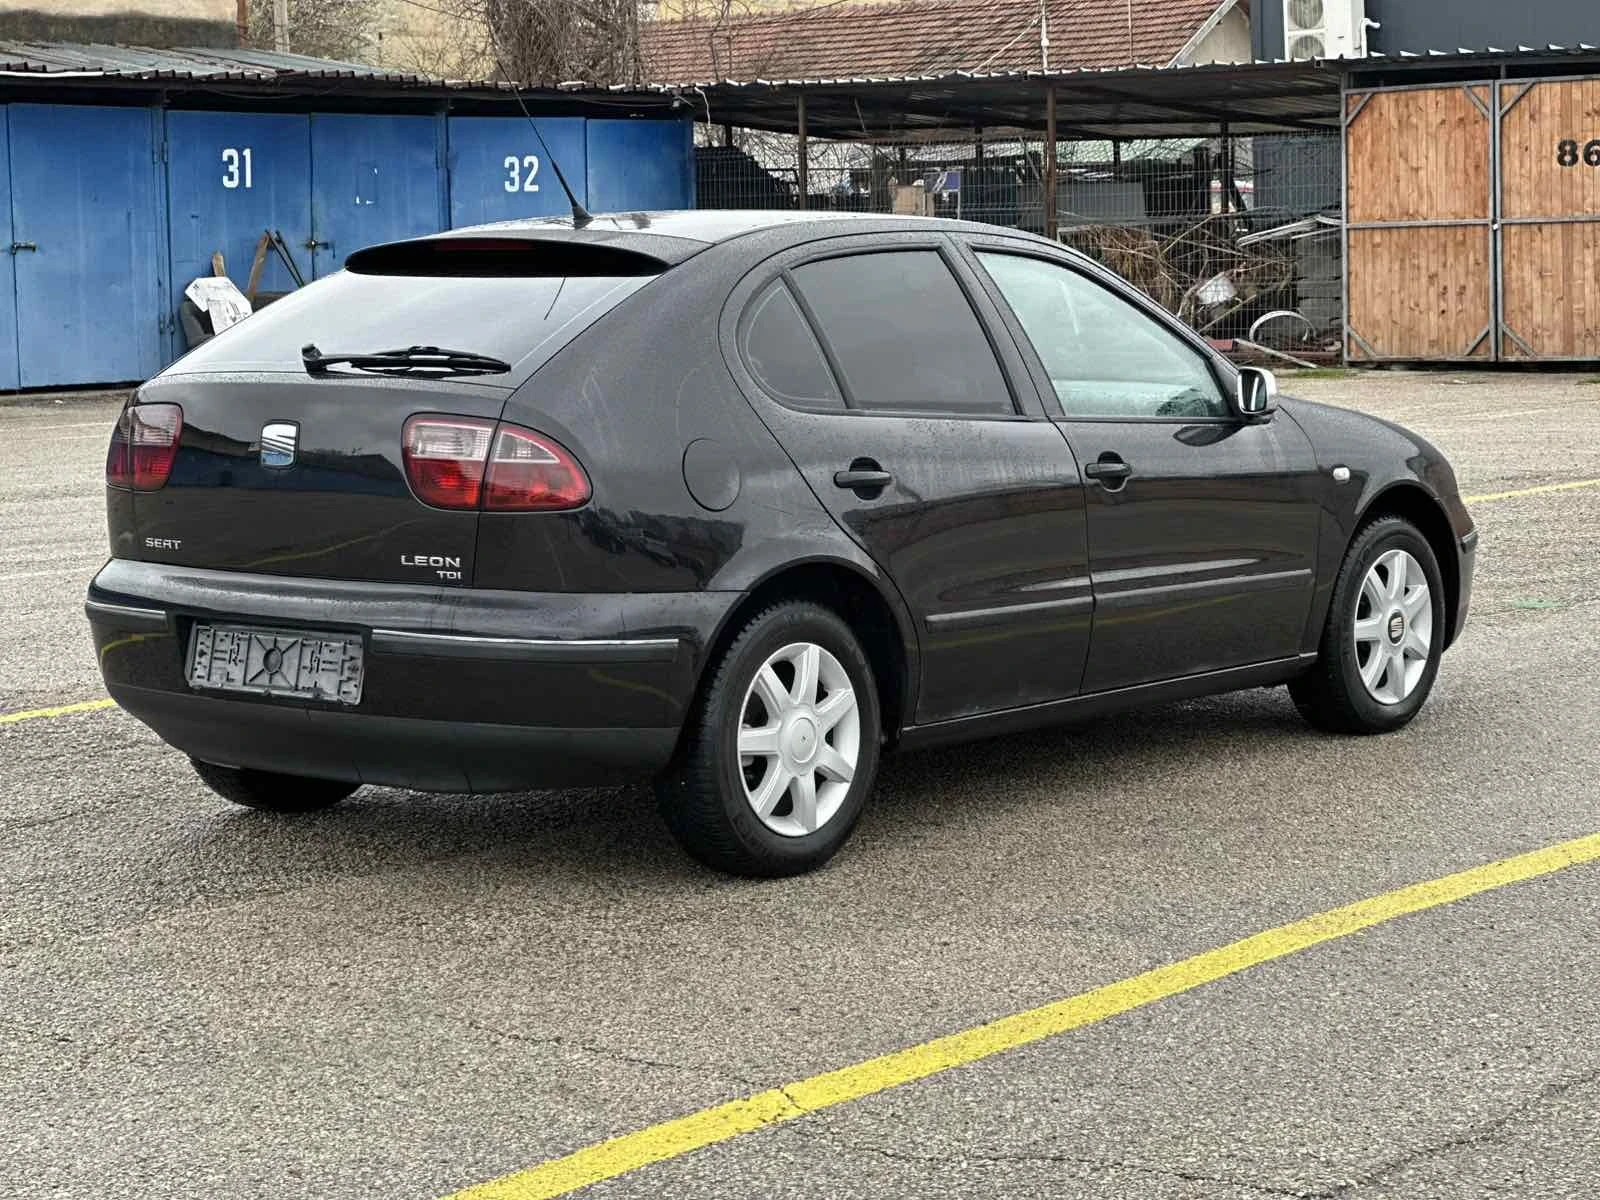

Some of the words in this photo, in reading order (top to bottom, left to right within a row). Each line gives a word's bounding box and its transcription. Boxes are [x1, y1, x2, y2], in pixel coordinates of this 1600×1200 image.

[1557, 139, 1600, 167] 86
[222, 148, 252, 188] 31
[504, 155, 539, 192] 32
[145, 537, 182, 550] SEAT
[400, 555, 461, 568] LEON
[436, 570, 462, 580] TDI
